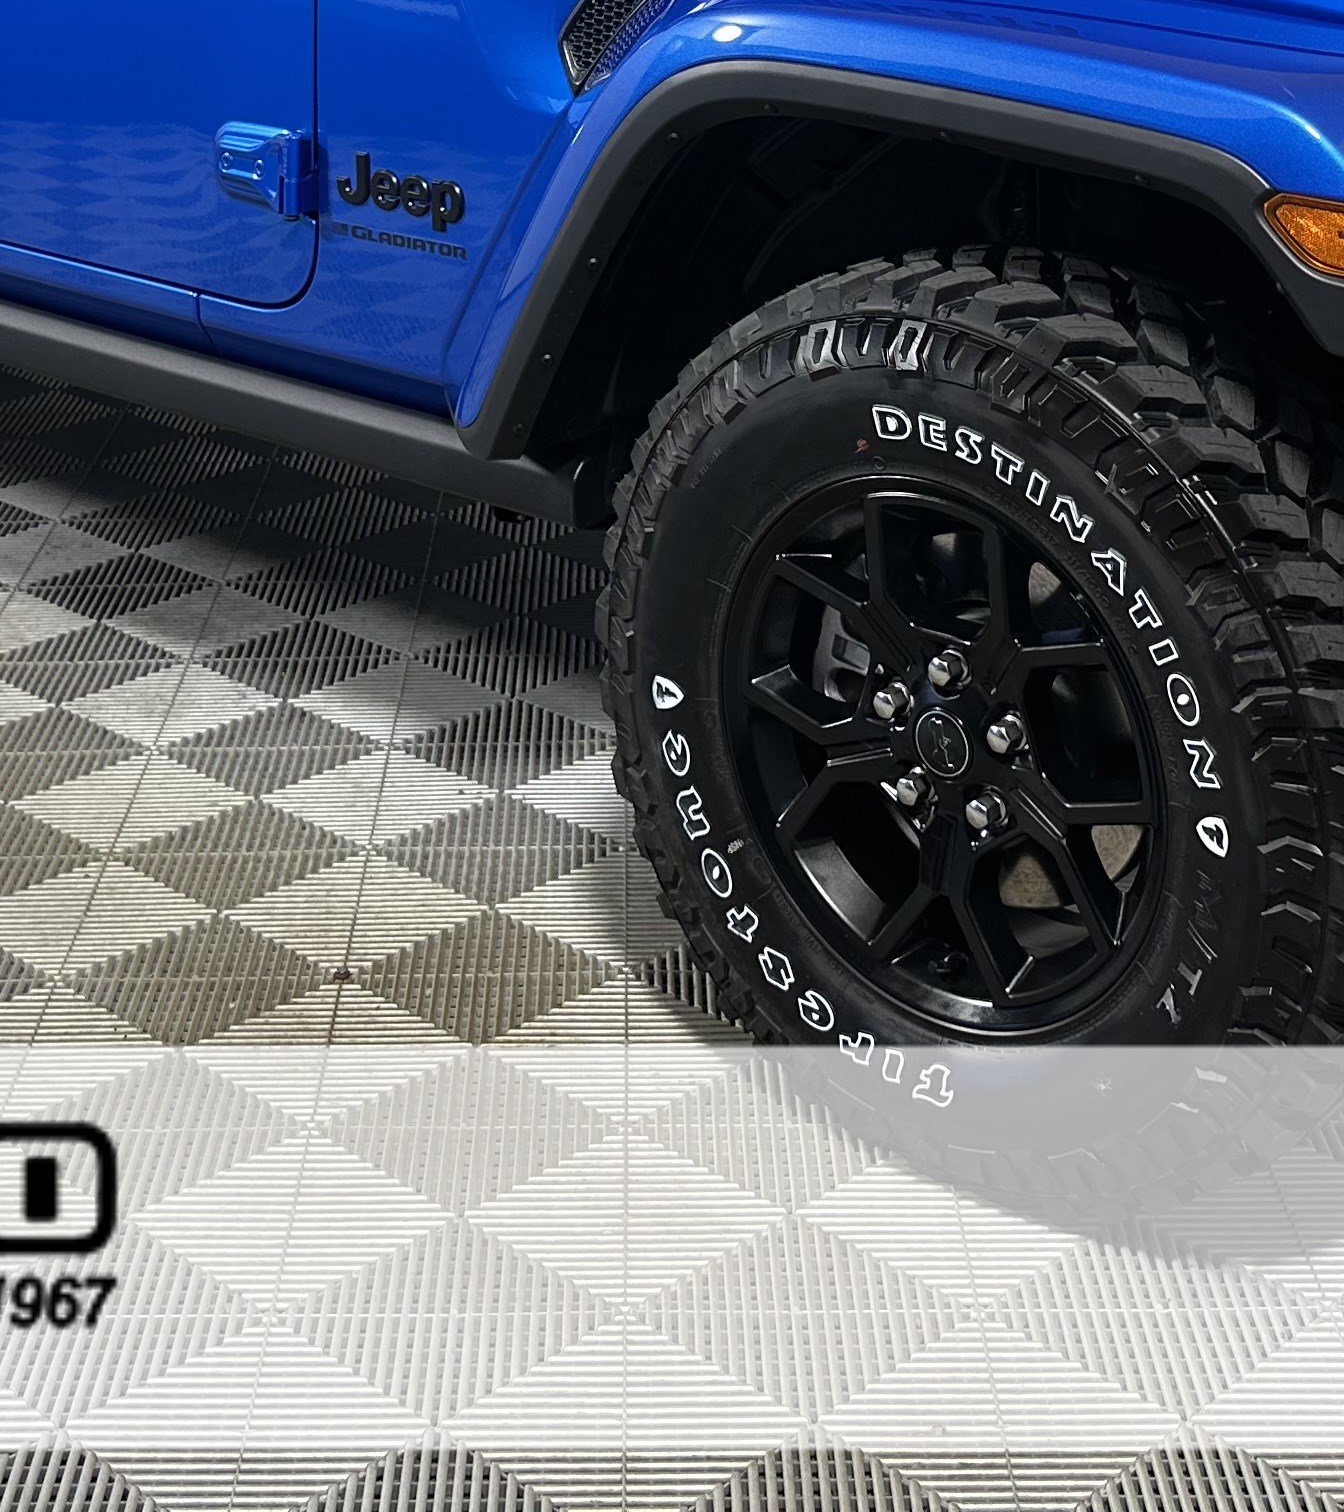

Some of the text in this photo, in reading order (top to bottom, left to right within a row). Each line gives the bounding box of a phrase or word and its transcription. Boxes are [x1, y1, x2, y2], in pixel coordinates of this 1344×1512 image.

[336, 151, 466, 233] Jeep
[351, 224, 468, 261] GLADIATOR
[872, 404, 1222, 792] DESTINATION
